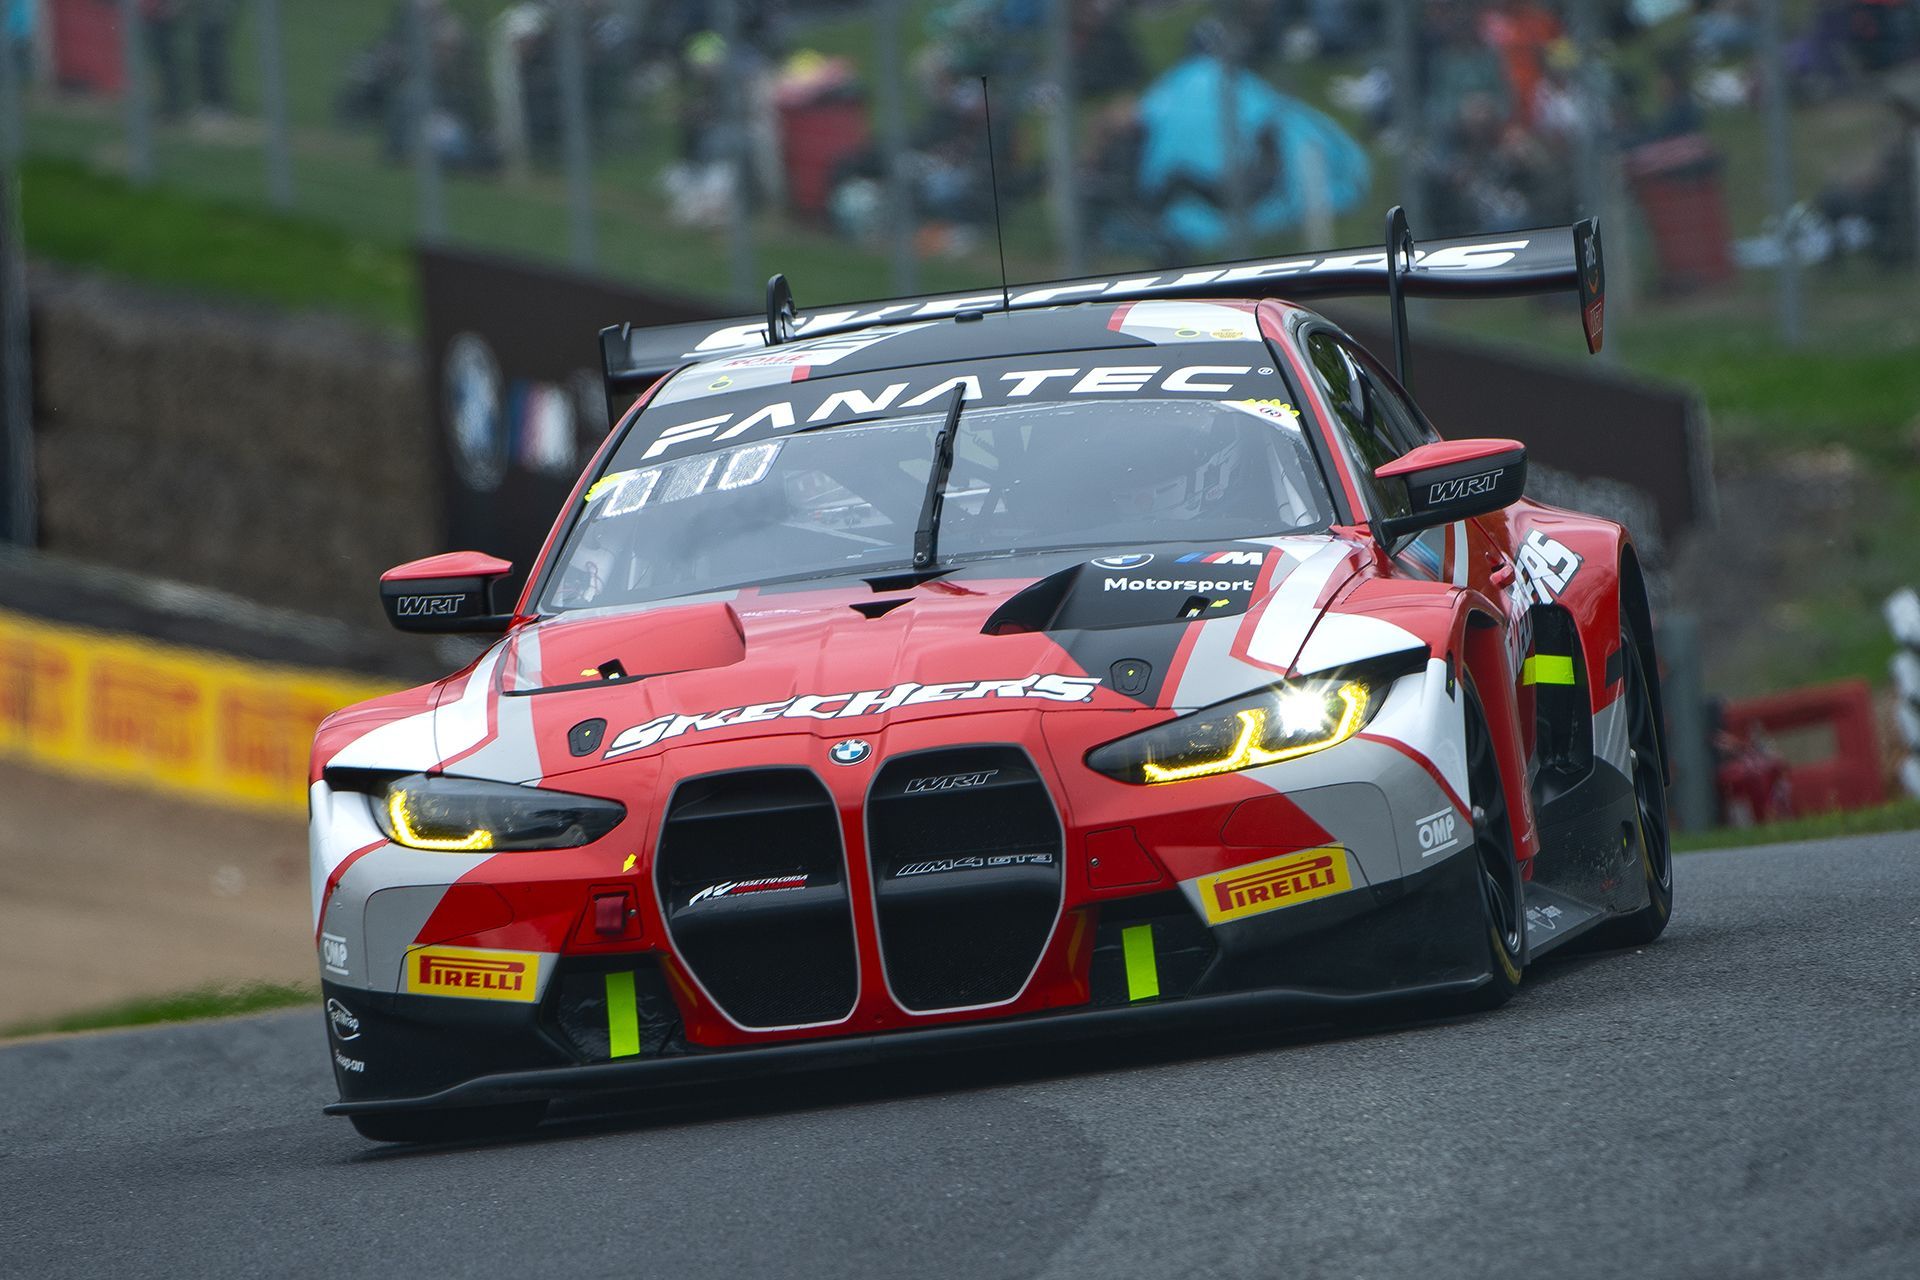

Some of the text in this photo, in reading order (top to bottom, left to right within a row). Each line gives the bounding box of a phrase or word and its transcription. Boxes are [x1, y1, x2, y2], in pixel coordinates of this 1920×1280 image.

[641, 366, 1252, 460] FANATEC
[1428, 468, 1504, 504] WRT
[1104, 577, 1254, 594] Motorsport
[397, 594, 466, 616] WRT
[603, 674, 1103, 760] SKECHERS
[904, 769, 1000, 794] WRT
[1418, 815, 1455, 849] OMP
[988, 853, 1053, 867] GT3
[1214, 855, 1333, 912] PIRELLI
[419, 955, 526, 991] PIRELLI
